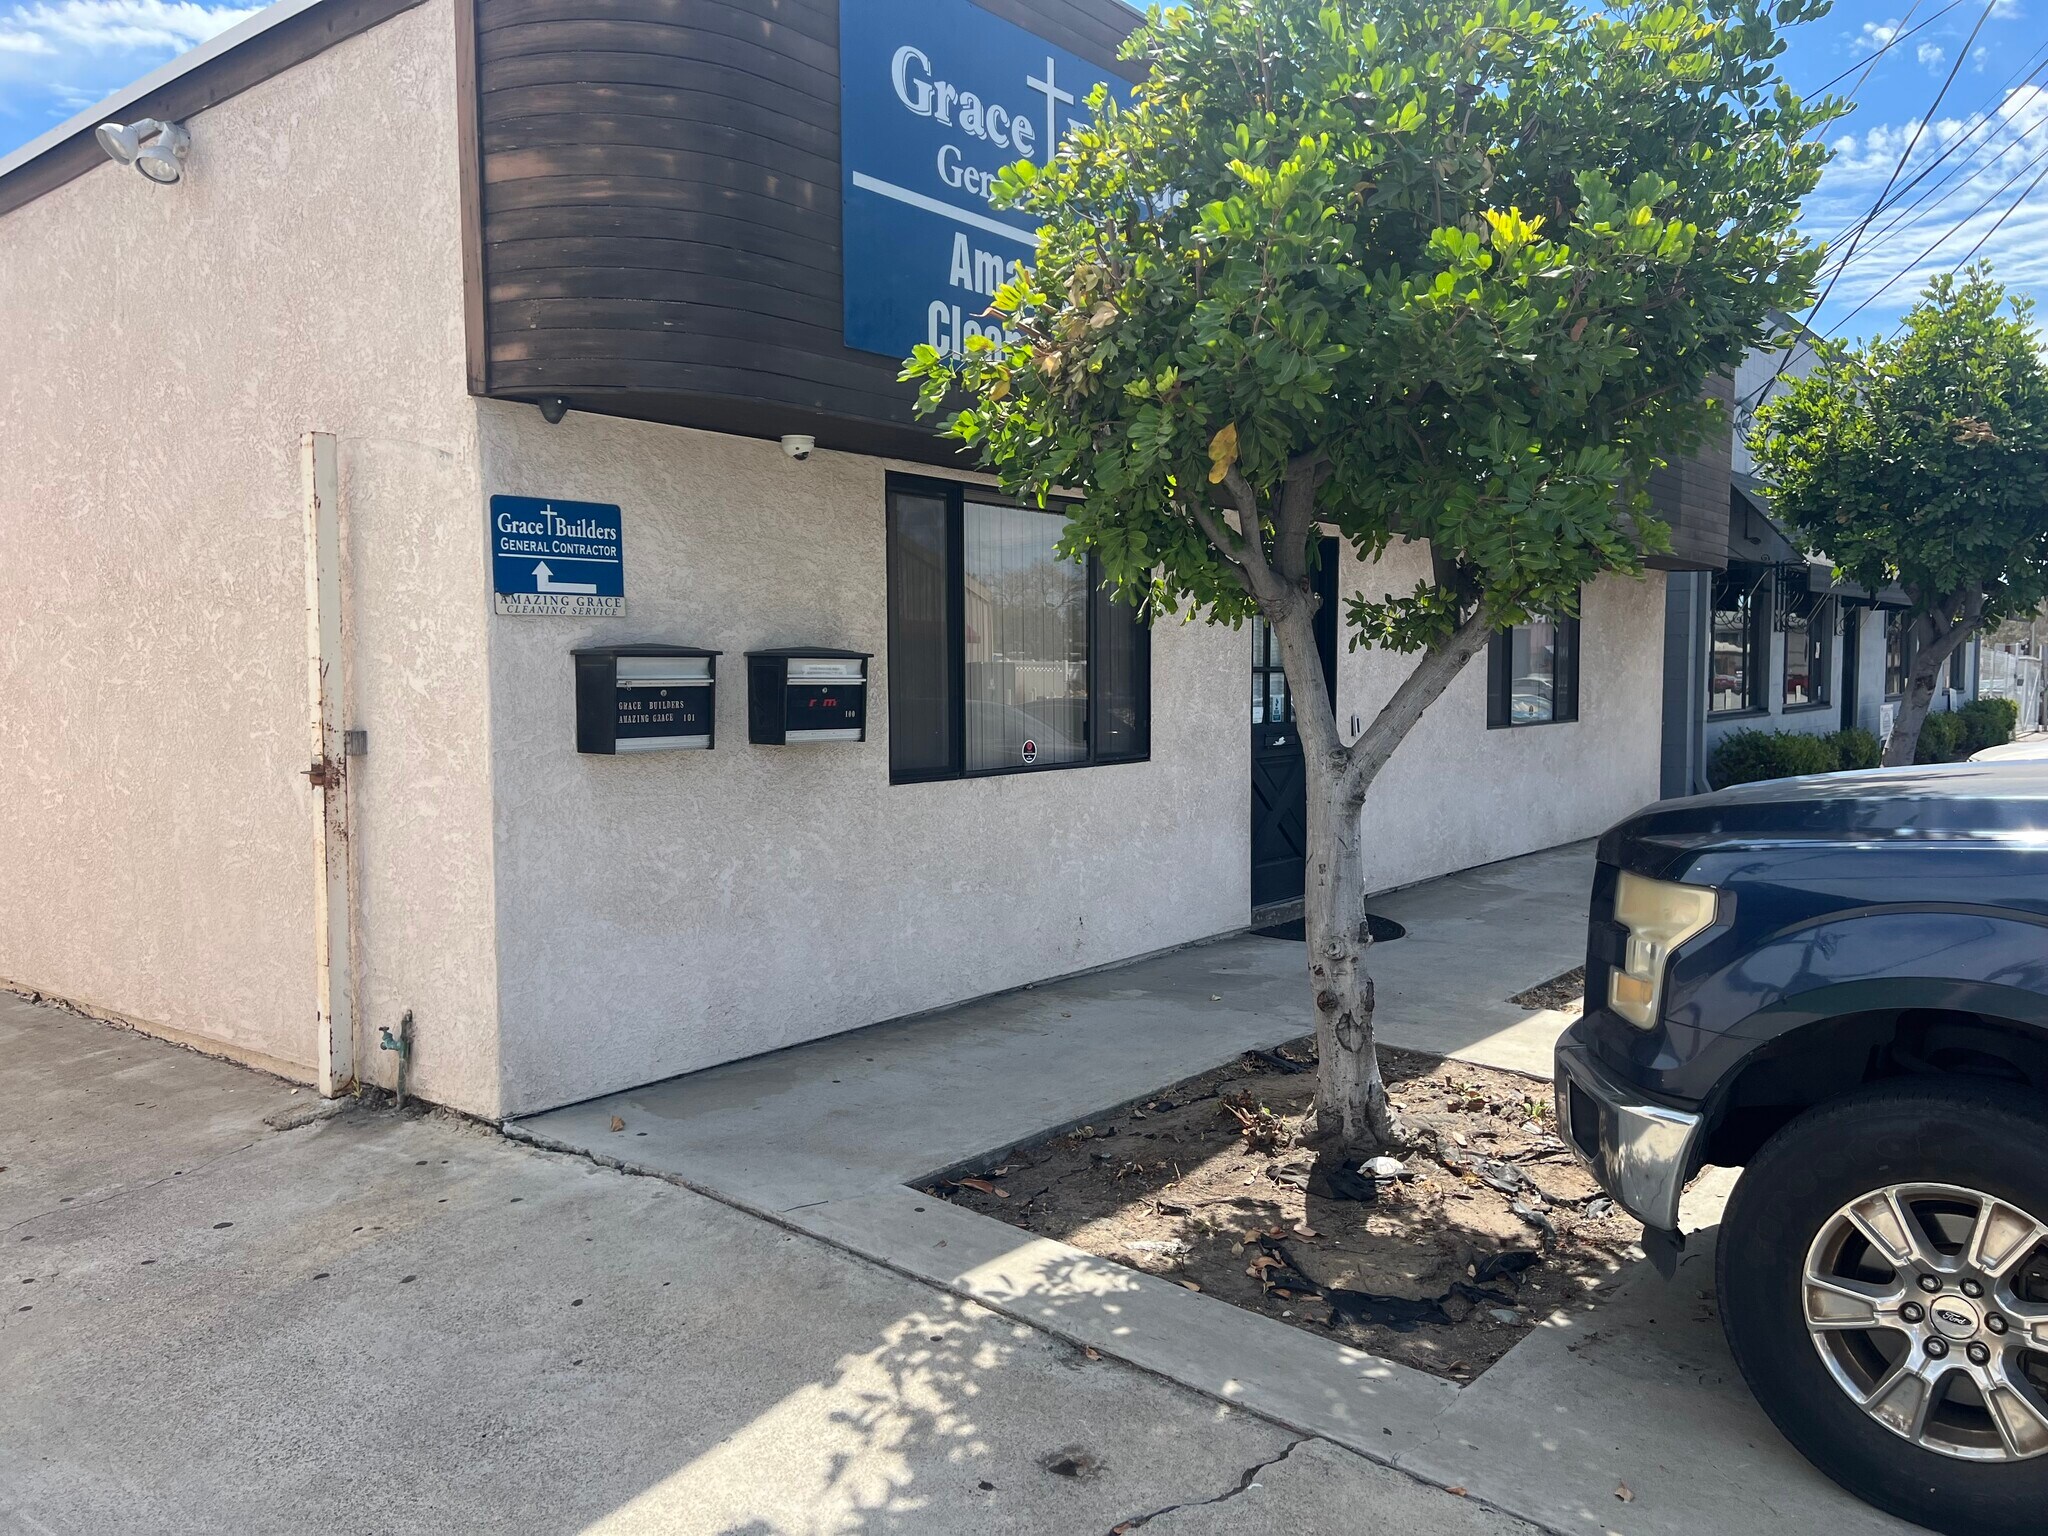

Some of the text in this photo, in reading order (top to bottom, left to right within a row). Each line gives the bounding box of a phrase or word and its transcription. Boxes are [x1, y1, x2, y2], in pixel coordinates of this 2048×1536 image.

[891, 45, 1036, 159] Grace
[497, 512, 617, 541] Grace Builders
[500, 537, 617, 557] GENERAL CONTRACTOR
[500, 595, 622, 608] AMAZING GRACE
[506, 605, 618, 616] CLEANING SERVICE
[618, 700, 685, 711] GRACE BUILDERS
[618, 714, 650, 724] AMAZING
[683, 713, 695, 722] 101
[1942, 1311, 1966, 1325] Ford
